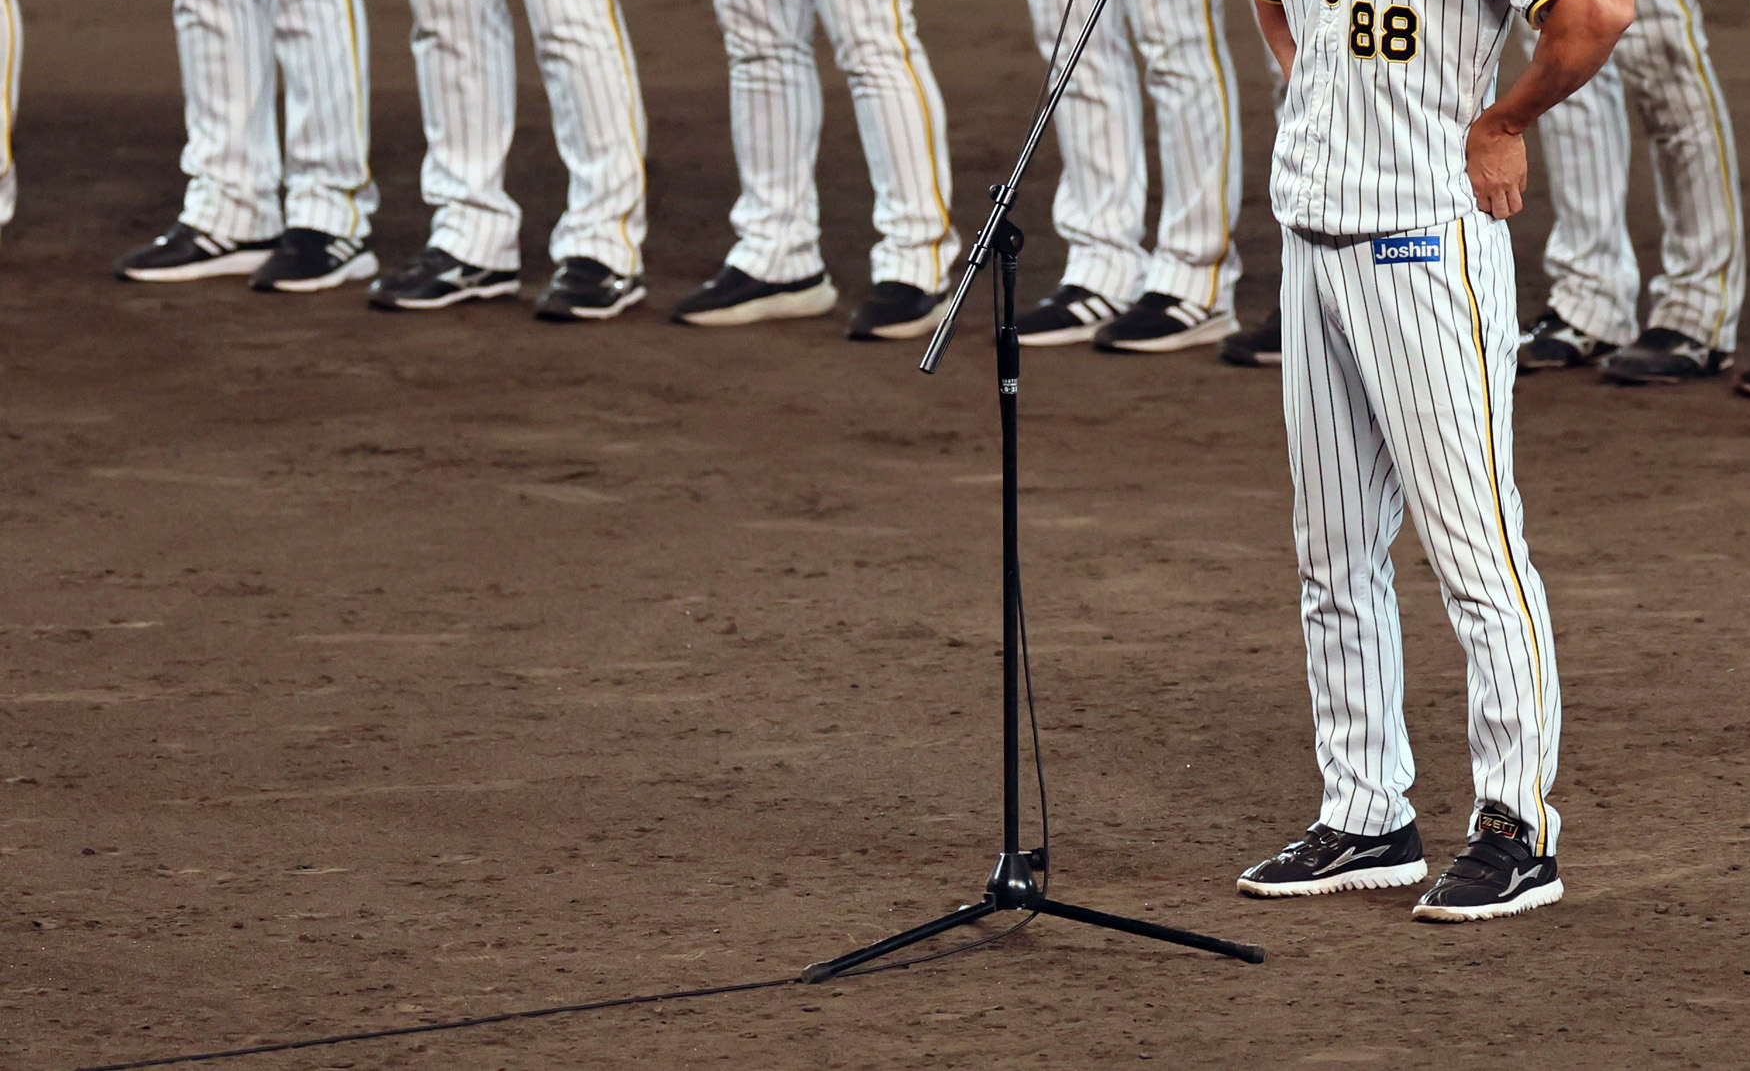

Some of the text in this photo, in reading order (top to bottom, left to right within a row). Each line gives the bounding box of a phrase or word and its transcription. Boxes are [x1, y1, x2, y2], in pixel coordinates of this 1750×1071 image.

[1349, 0, 1420, 63] 88
[1375, 241, 1440, 260] Joshin
[1482, 816, 1516, 832] ZETT
